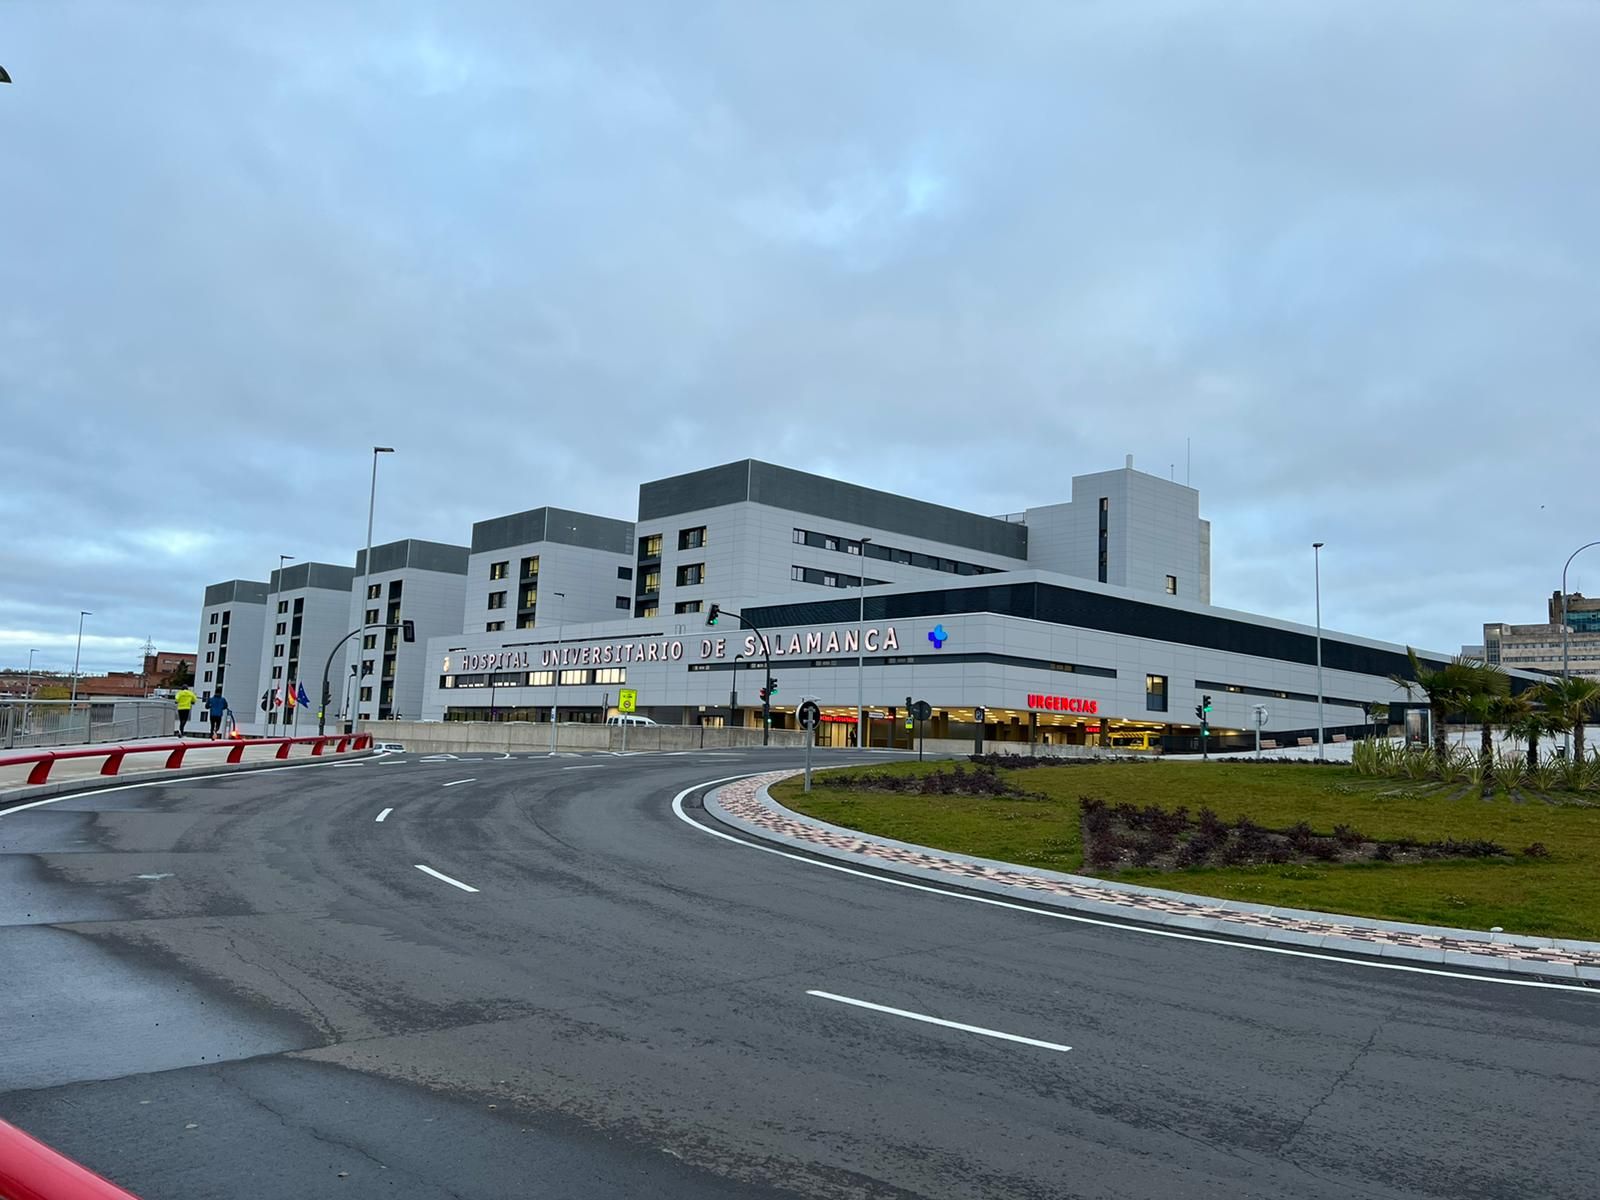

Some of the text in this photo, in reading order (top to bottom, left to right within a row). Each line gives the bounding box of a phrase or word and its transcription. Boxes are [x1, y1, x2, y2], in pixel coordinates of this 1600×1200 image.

[462, 627, 899, 671] HOSPITAL UNIVERSITARIO DE SALAMANCA
[1027, 694, 1098, 714] URGENCIAS
